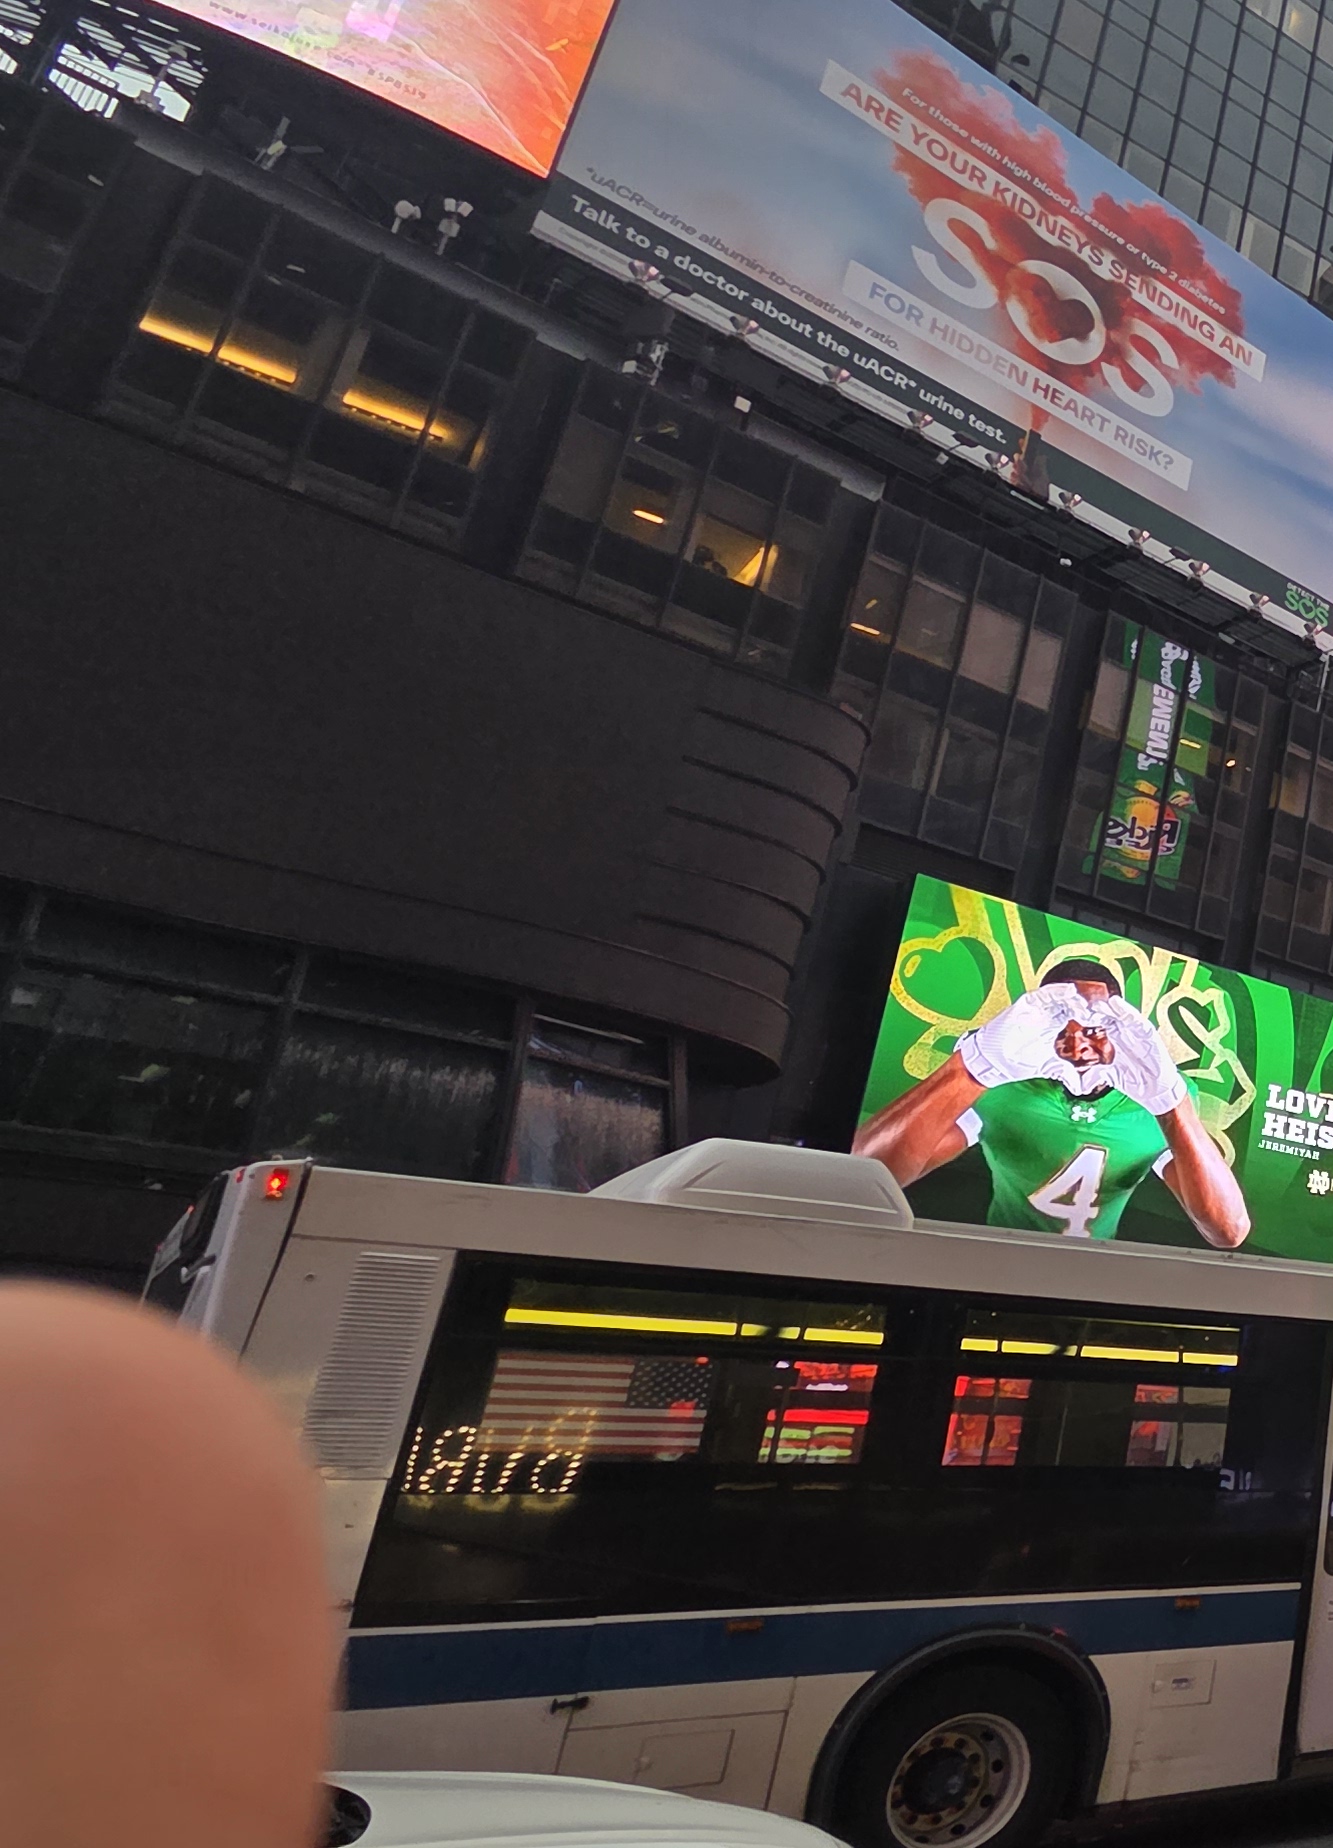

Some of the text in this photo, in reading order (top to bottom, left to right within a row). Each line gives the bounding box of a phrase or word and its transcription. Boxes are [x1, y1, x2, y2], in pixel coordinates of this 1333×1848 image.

[698, 233, 863, 330] albumin-to-creatinine
[864, 326, 900, 352] ratio.
[840, 83, 1254, 367] ARE YOUR KIDNEYS SENDING AN
[902, 87, 1226, 316] For those with high blood pressure or type 2 diabetes
[911, 197, 1179, 418] SOS
[571, 194, 620, 235] Talk
[626, 226, 651, 249] to
[654, 244, 670, 260] a
[673, 251, 750, 301] doctor
[751, 296, 814, 340] about
[816, 330, 850, 358] the
[918, 387, 966, 421] urine
[968, 413, 1007, 444] test.
[868, 281, 1175, 471] FOR HIDDEN HEART RISK?
[1027, 1143, 1109, 1240] 4
